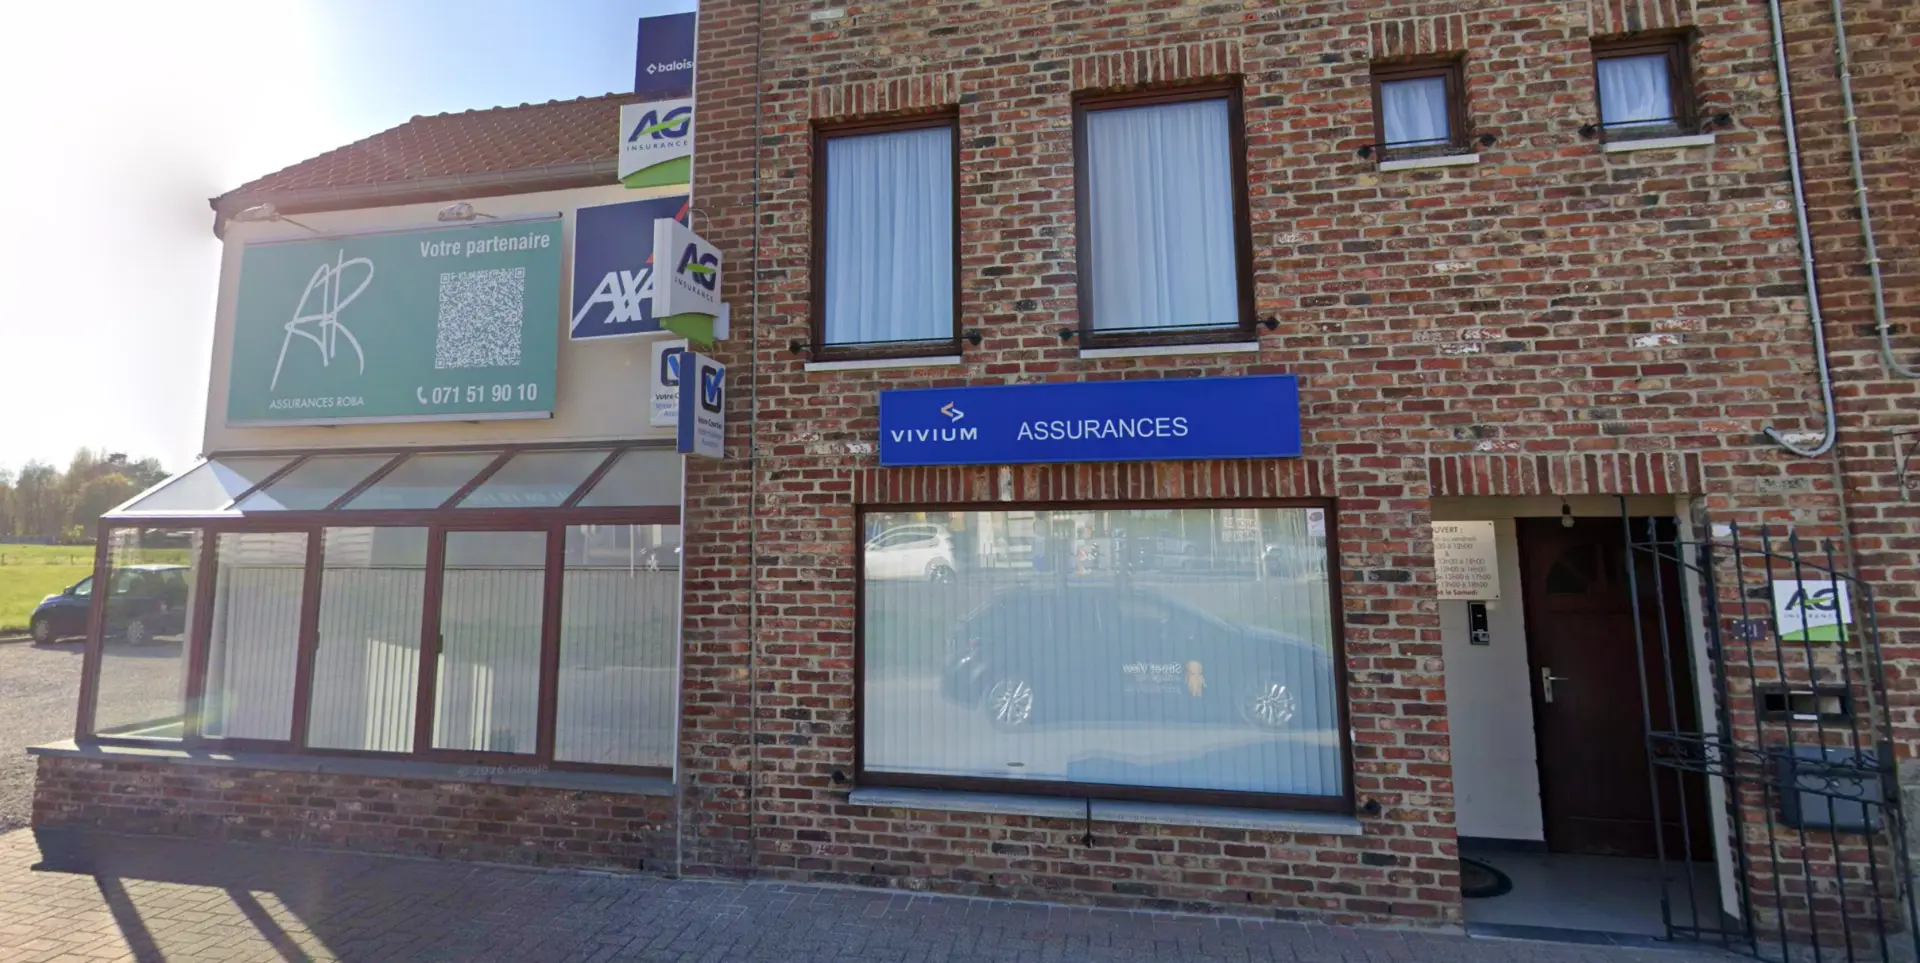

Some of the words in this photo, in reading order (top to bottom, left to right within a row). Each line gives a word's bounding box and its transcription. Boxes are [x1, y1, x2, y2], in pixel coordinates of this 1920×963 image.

[628, 107, 692, 142] AG
[627, 140, 688, 151] INSURANCE
[420, 241, 460, 257] Votre
[466, 232, 550, 257] partenaire
[676, 243, 718, 291] AG
[675, 276, 714, 303] INSURANCE
[269, 397, 334, 409] ASSURANCES
[336, 396, 365, 407] ROBA
[432, 386, 460, 404] 071
[466, 385, 484, 403] 51
[491, 384, 511, 402] 90
[517, 383, 538, 401] 10
[891, 427, 978, 442] VIVIUM
[1017, 417, 1189, 441] ASSURANCES
